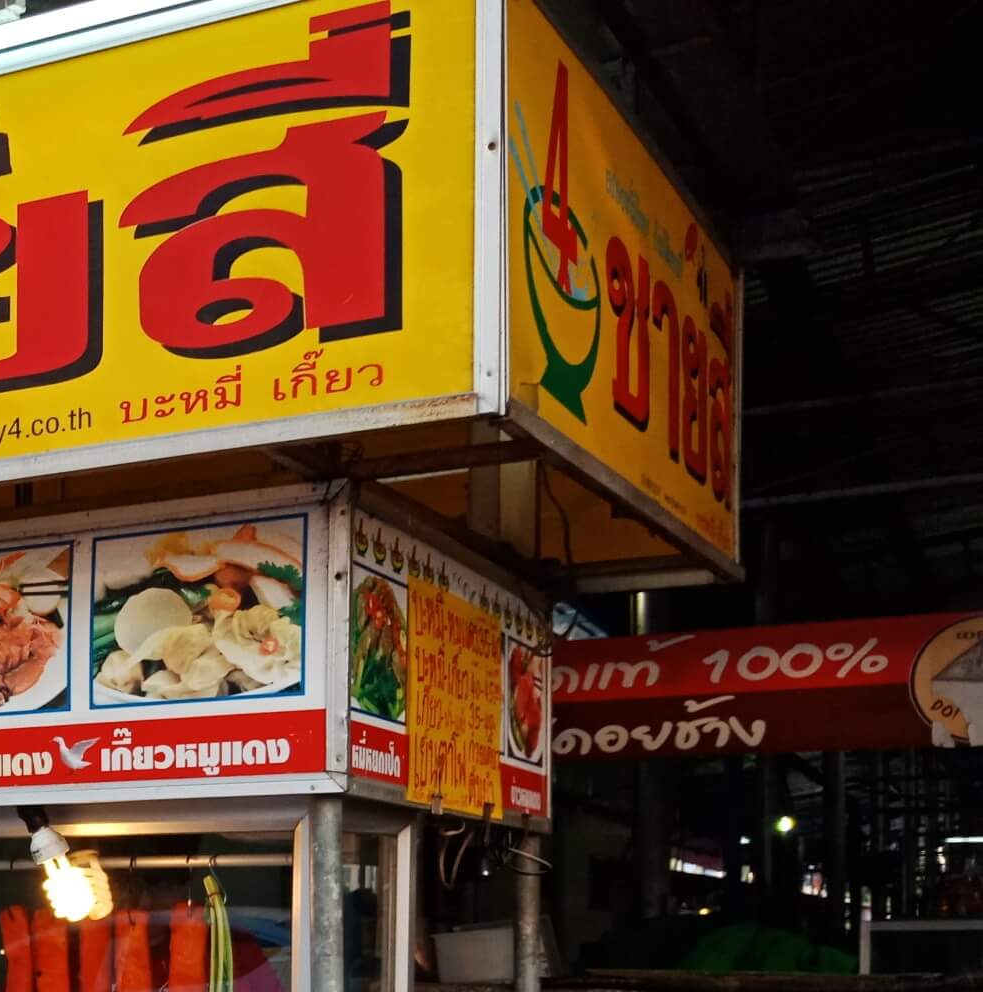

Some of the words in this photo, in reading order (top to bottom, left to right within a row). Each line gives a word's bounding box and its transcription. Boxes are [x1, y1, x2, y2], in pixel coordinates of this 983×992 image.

[118, 364, 243, 425] บะหมี่
[273, 348, 385, 401] เกี๊ยว
[701, 637, 889, 684] 100%
[100, 727, 291, 777] เกี๊ยวหมูแดง
